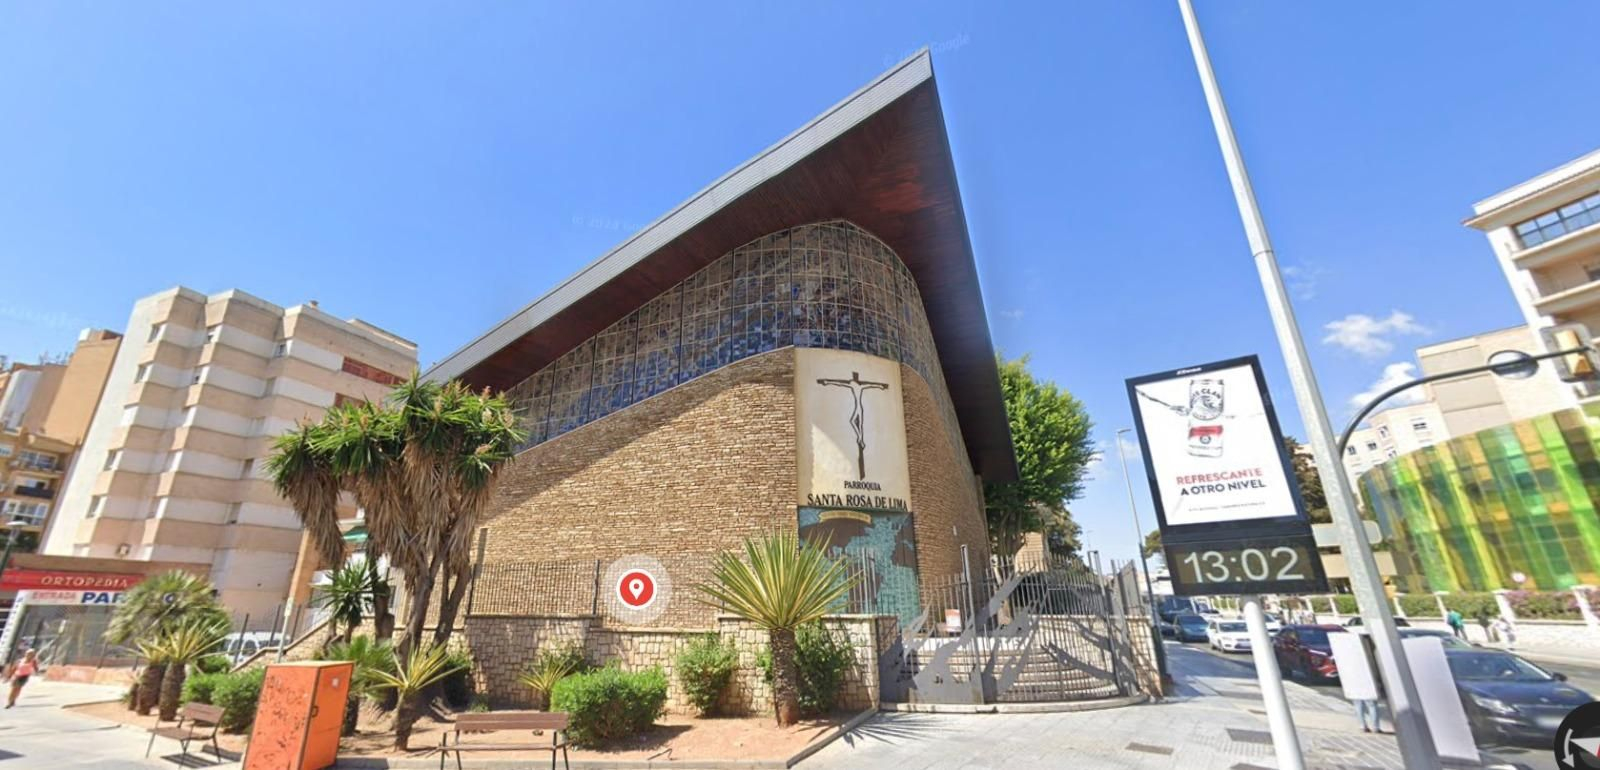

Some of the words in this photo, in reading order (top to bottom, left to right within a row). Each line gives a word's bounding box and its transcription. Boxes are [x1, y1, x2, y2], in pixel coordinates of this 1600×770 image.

[1176, 468, 1263, 485] REFRESCANTE
[844, 480, 881, 491] PARROQUIA
[1180, 488, 1190, 496] A
[1190, 483, 1225, 495] OTRO
[1228, 479, 1267, 491] NIVEL
[807, 493, 843, 506] SANTA
[846, 494, 873, 507] ROSA
[874, 496, 887, 509] DE
[888, 498, 908, 512] LIMA
[1184, 546, 1304, 583] 13:02
[41, 575, 128, 588] ORTOPEDIA
